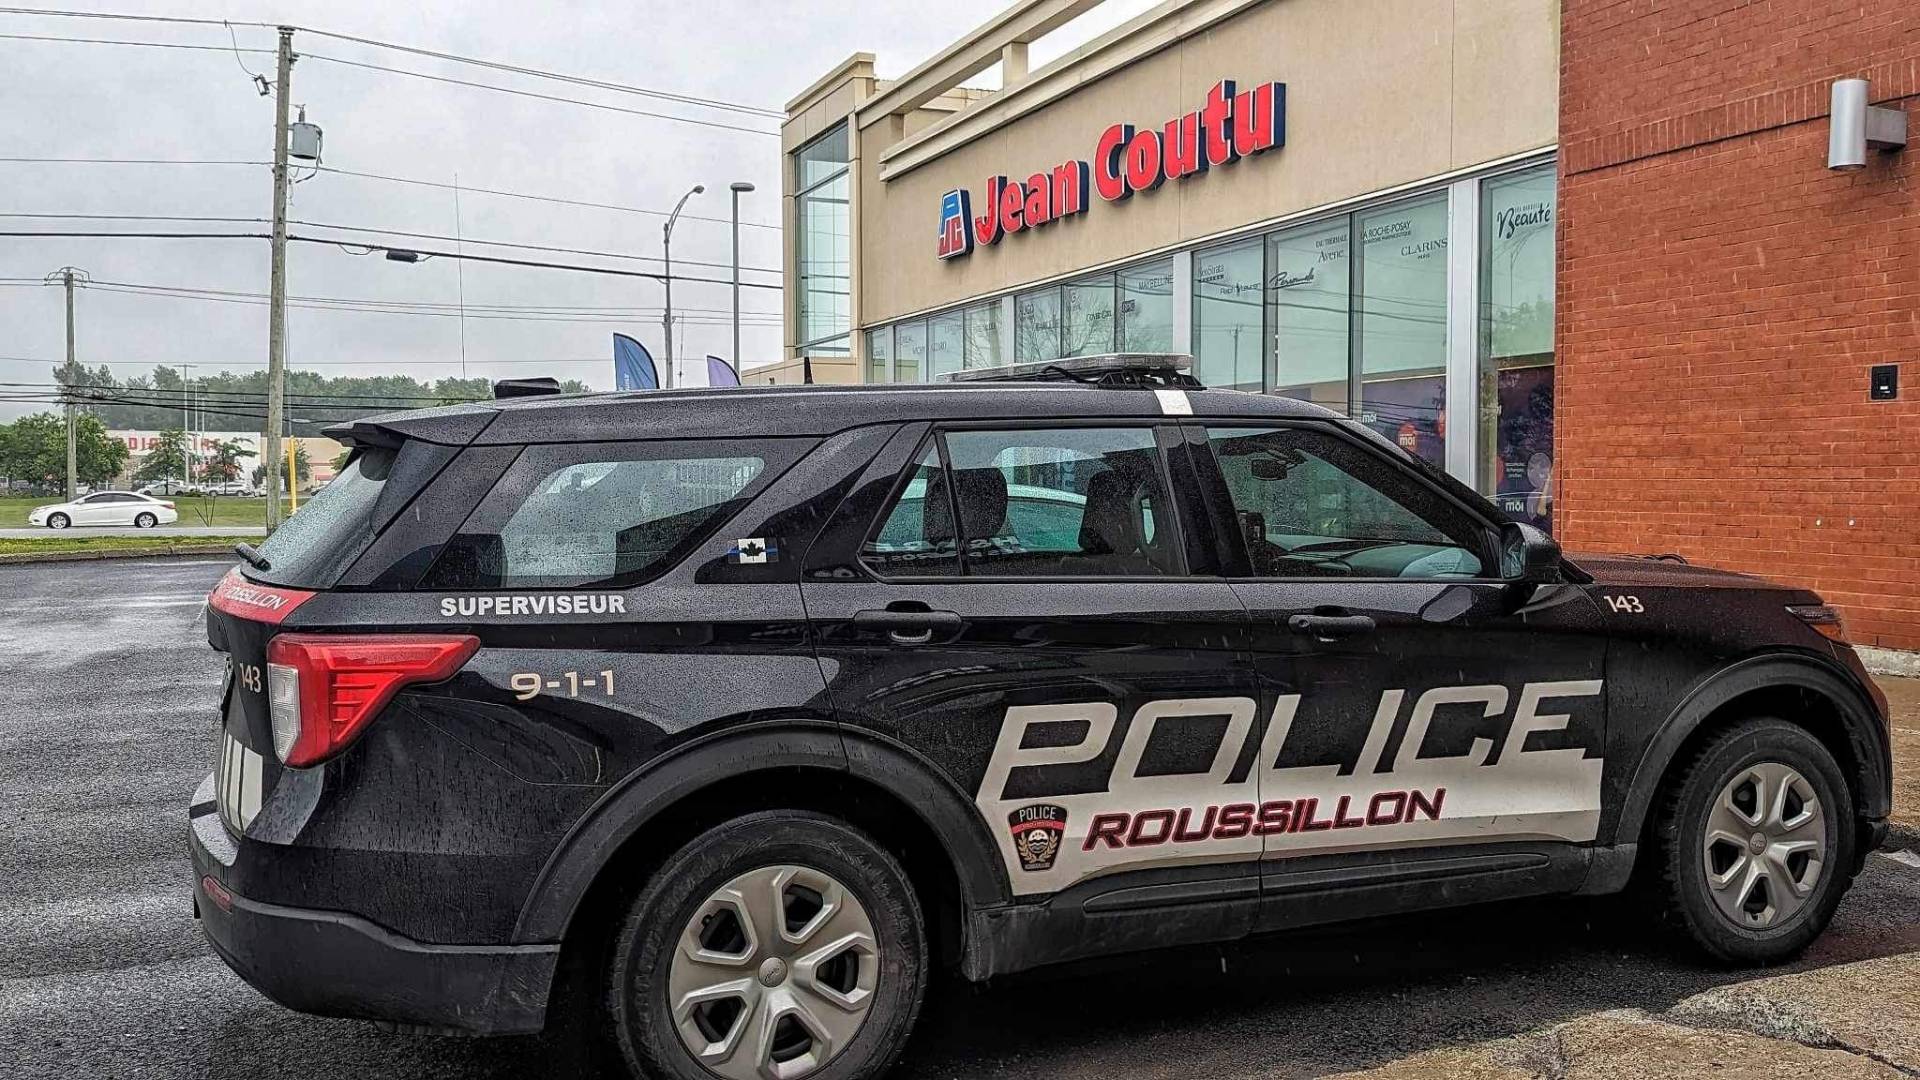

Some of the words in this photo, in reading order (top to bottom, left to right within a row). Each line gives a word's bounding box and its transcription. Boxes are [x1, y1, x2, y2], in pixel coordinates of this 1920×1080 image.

[974, 160, 1089, 246] Jean
[1094, 80, 1286, 201] Coutu
[1497, 202, 1551, 239] Beauté
[1401, 238, 1449, 256] CLARINS
[440, 594, 627, 617] SUPERVISEUR
[1604, 595, 1644, 613] 143
[240, 662, 261, 693] 143
[510, 669, 614, 700] 9-1-1
[978, 679, 1604, 803] POLICE
[1019, 806, 1057, 821] POLICE
[1081, 787, 1446, 852] ROUSSILLON
